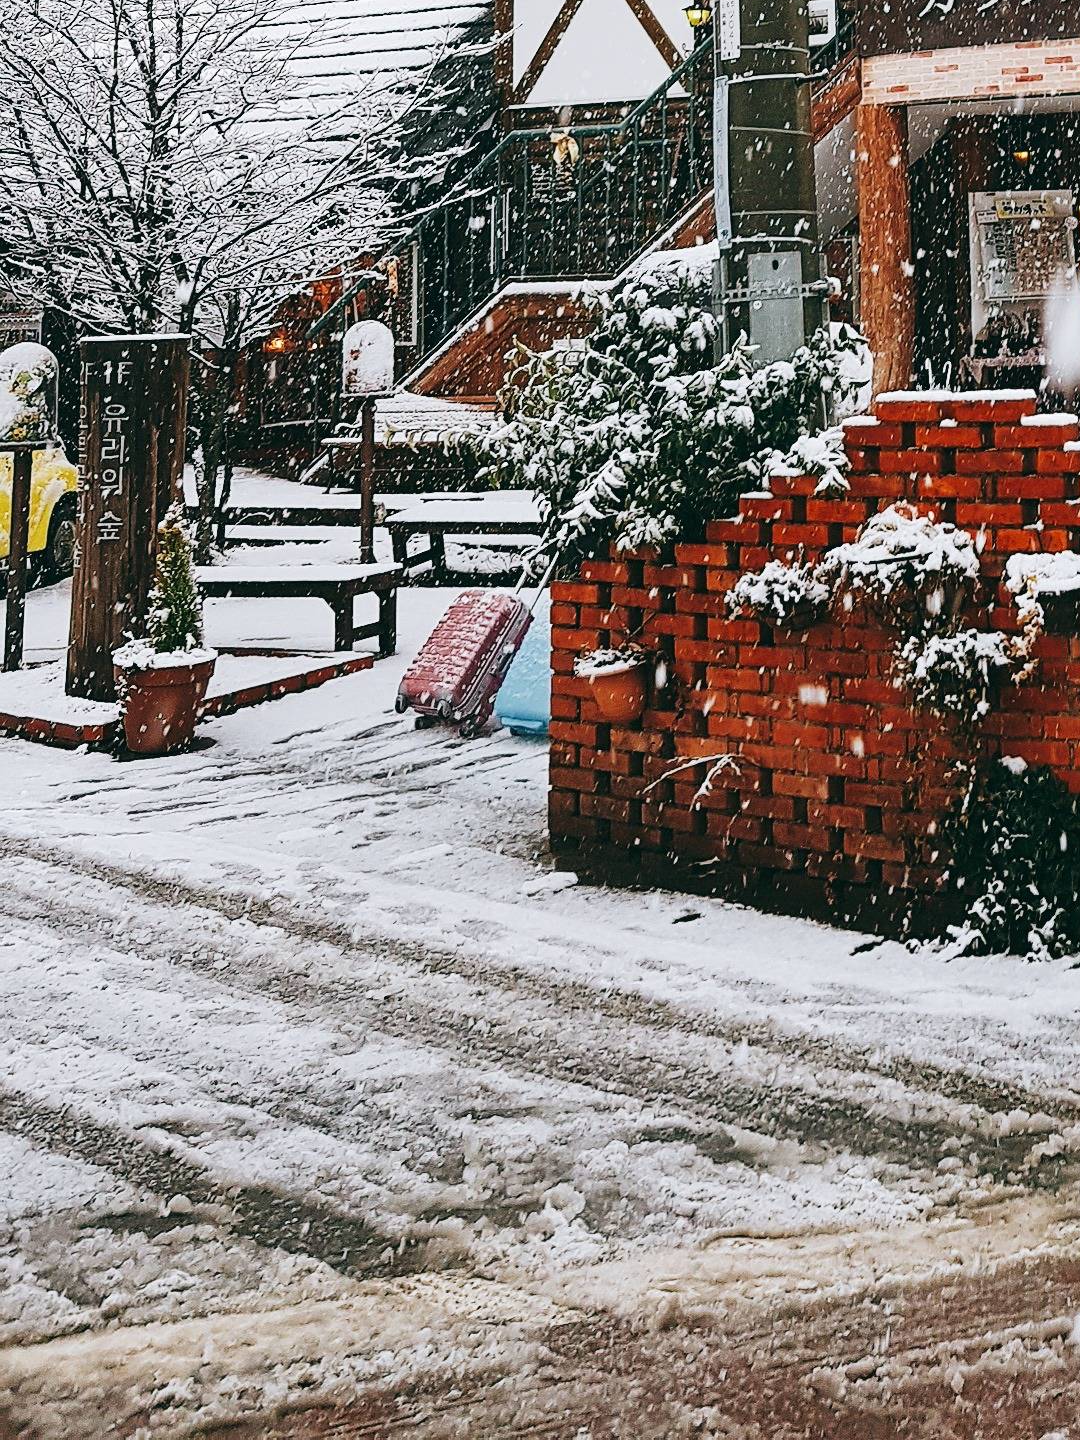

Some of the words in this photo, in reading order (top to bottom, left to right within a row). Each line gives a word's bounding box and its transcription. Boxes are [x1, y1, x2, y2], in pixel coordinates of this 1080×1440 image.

[103, 360, 134, 385] 1F
[100, 404, 130, 497] 유리의
[96, 511, 124, 542] 숲
